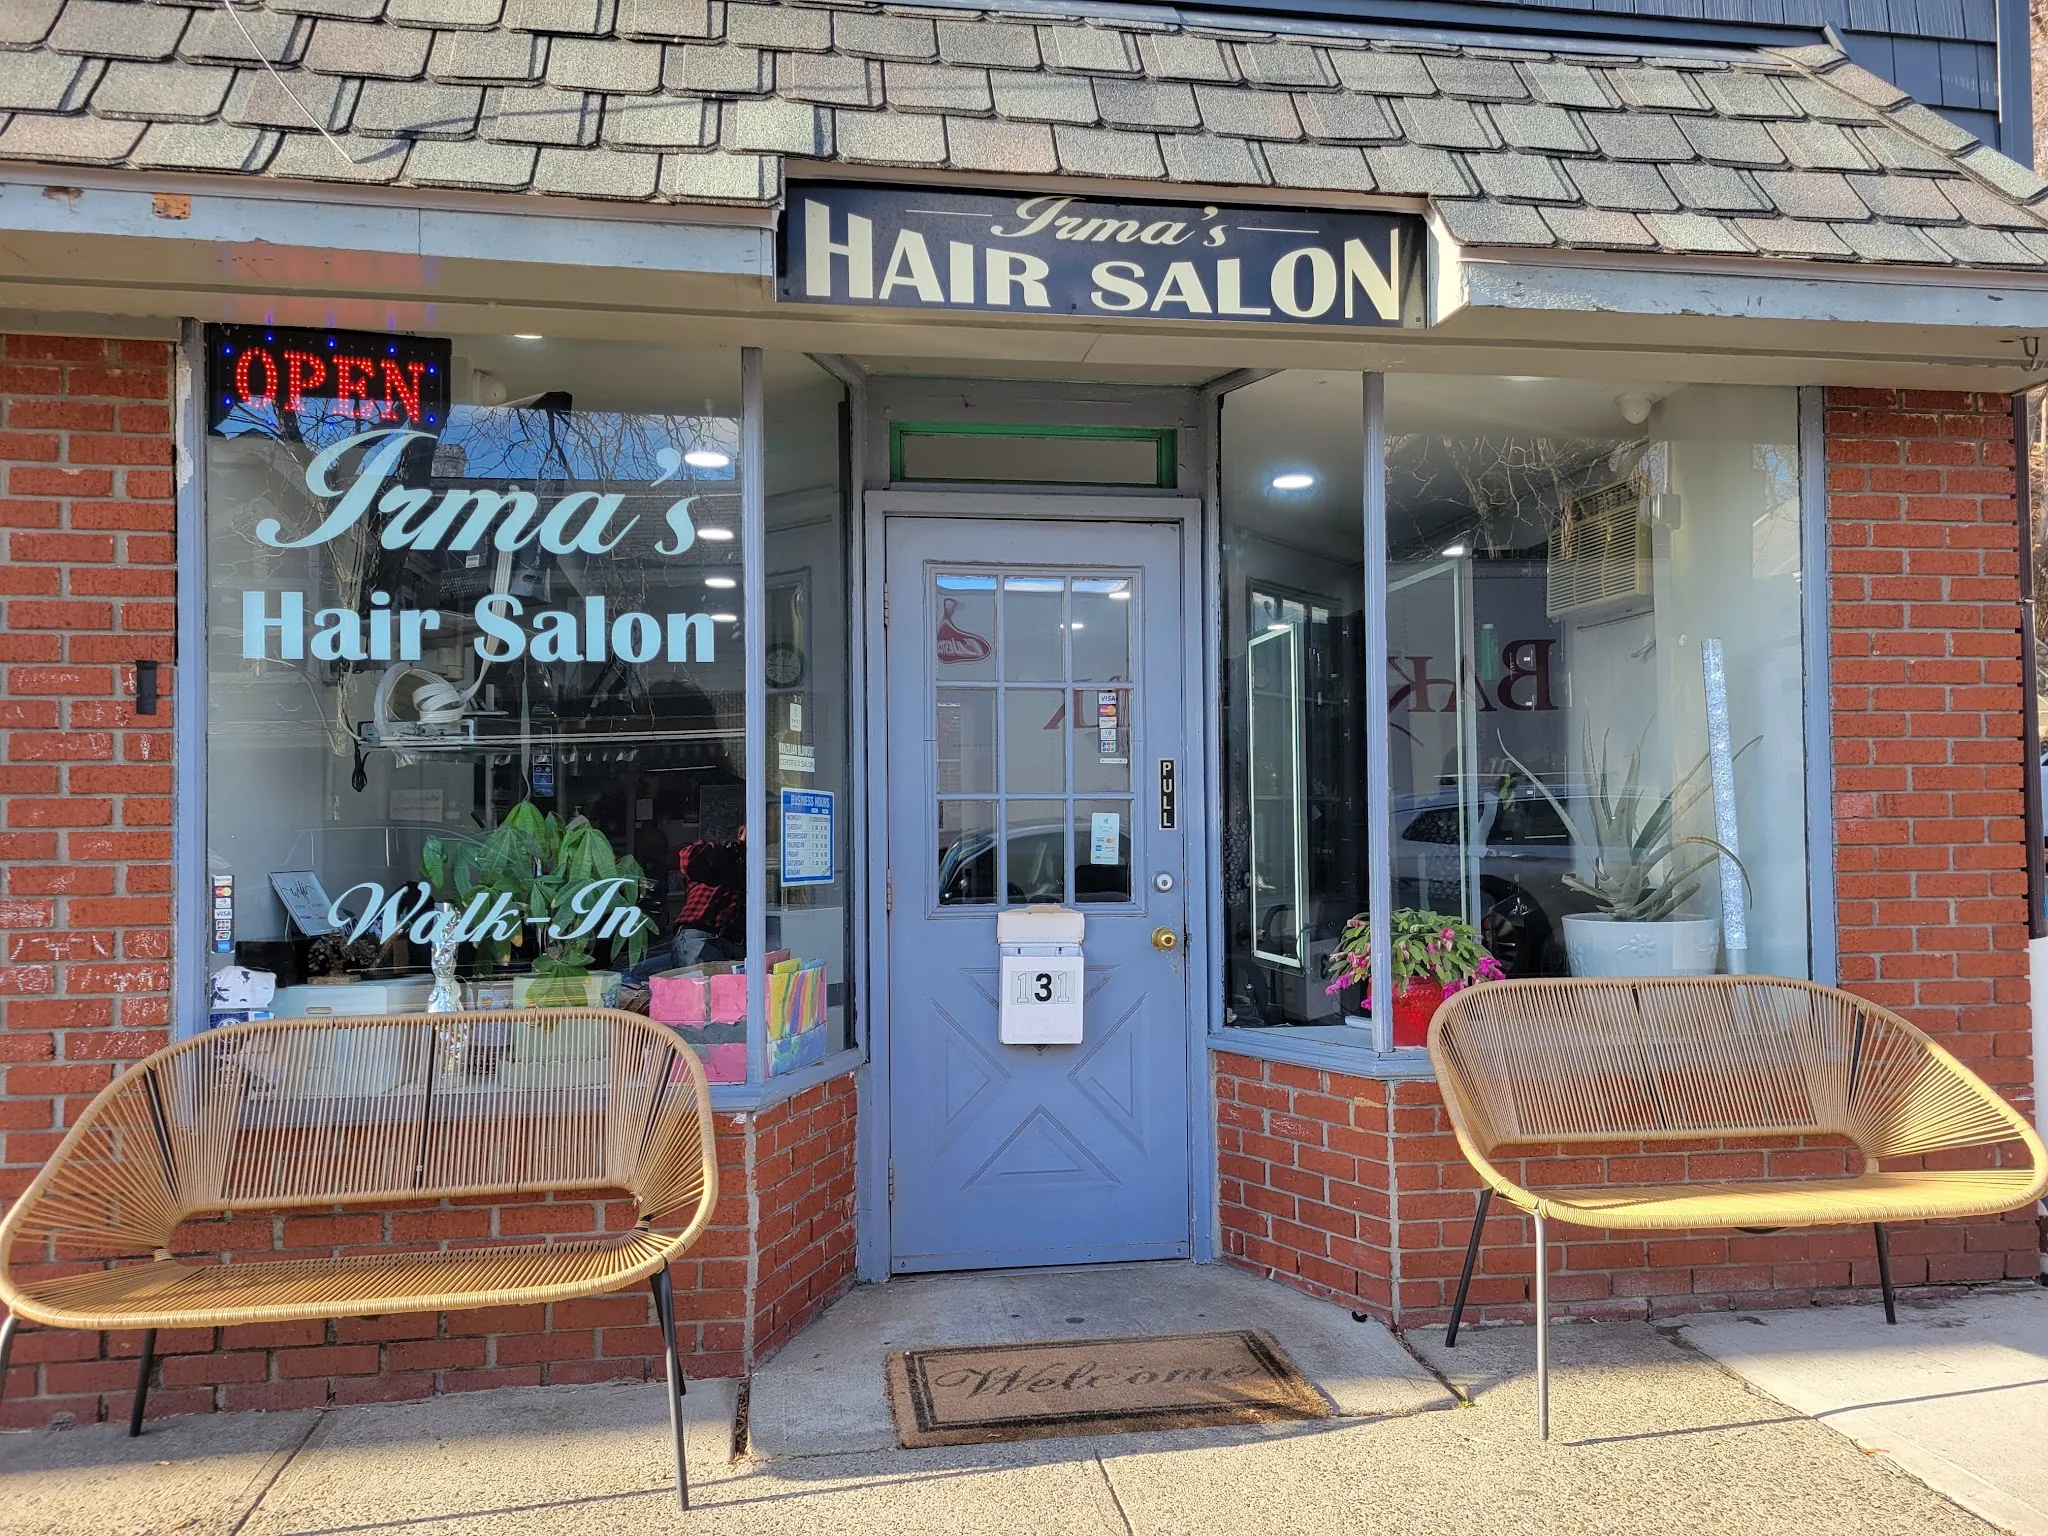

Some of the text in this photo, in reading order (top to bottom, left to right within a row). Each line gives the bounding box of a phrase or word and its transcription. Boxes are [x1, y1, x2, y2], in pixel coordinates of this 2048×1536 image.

[990, 196, 1228, 247] Irma's
[805, 199, 1400, 322] HAIR SALON
[235, 346, 424, 425] OPEN
[256, 428, 700, 556] Irma's
[242, 590, 715, 663] Hair Salon
[790, 794, 830, 808] BUSINESS HOURS
[1162, 761, 1173, 827] PULL
[328, 877, 649, 946] Walk-In
[934, 1360, 1262, 1400] Welcome
